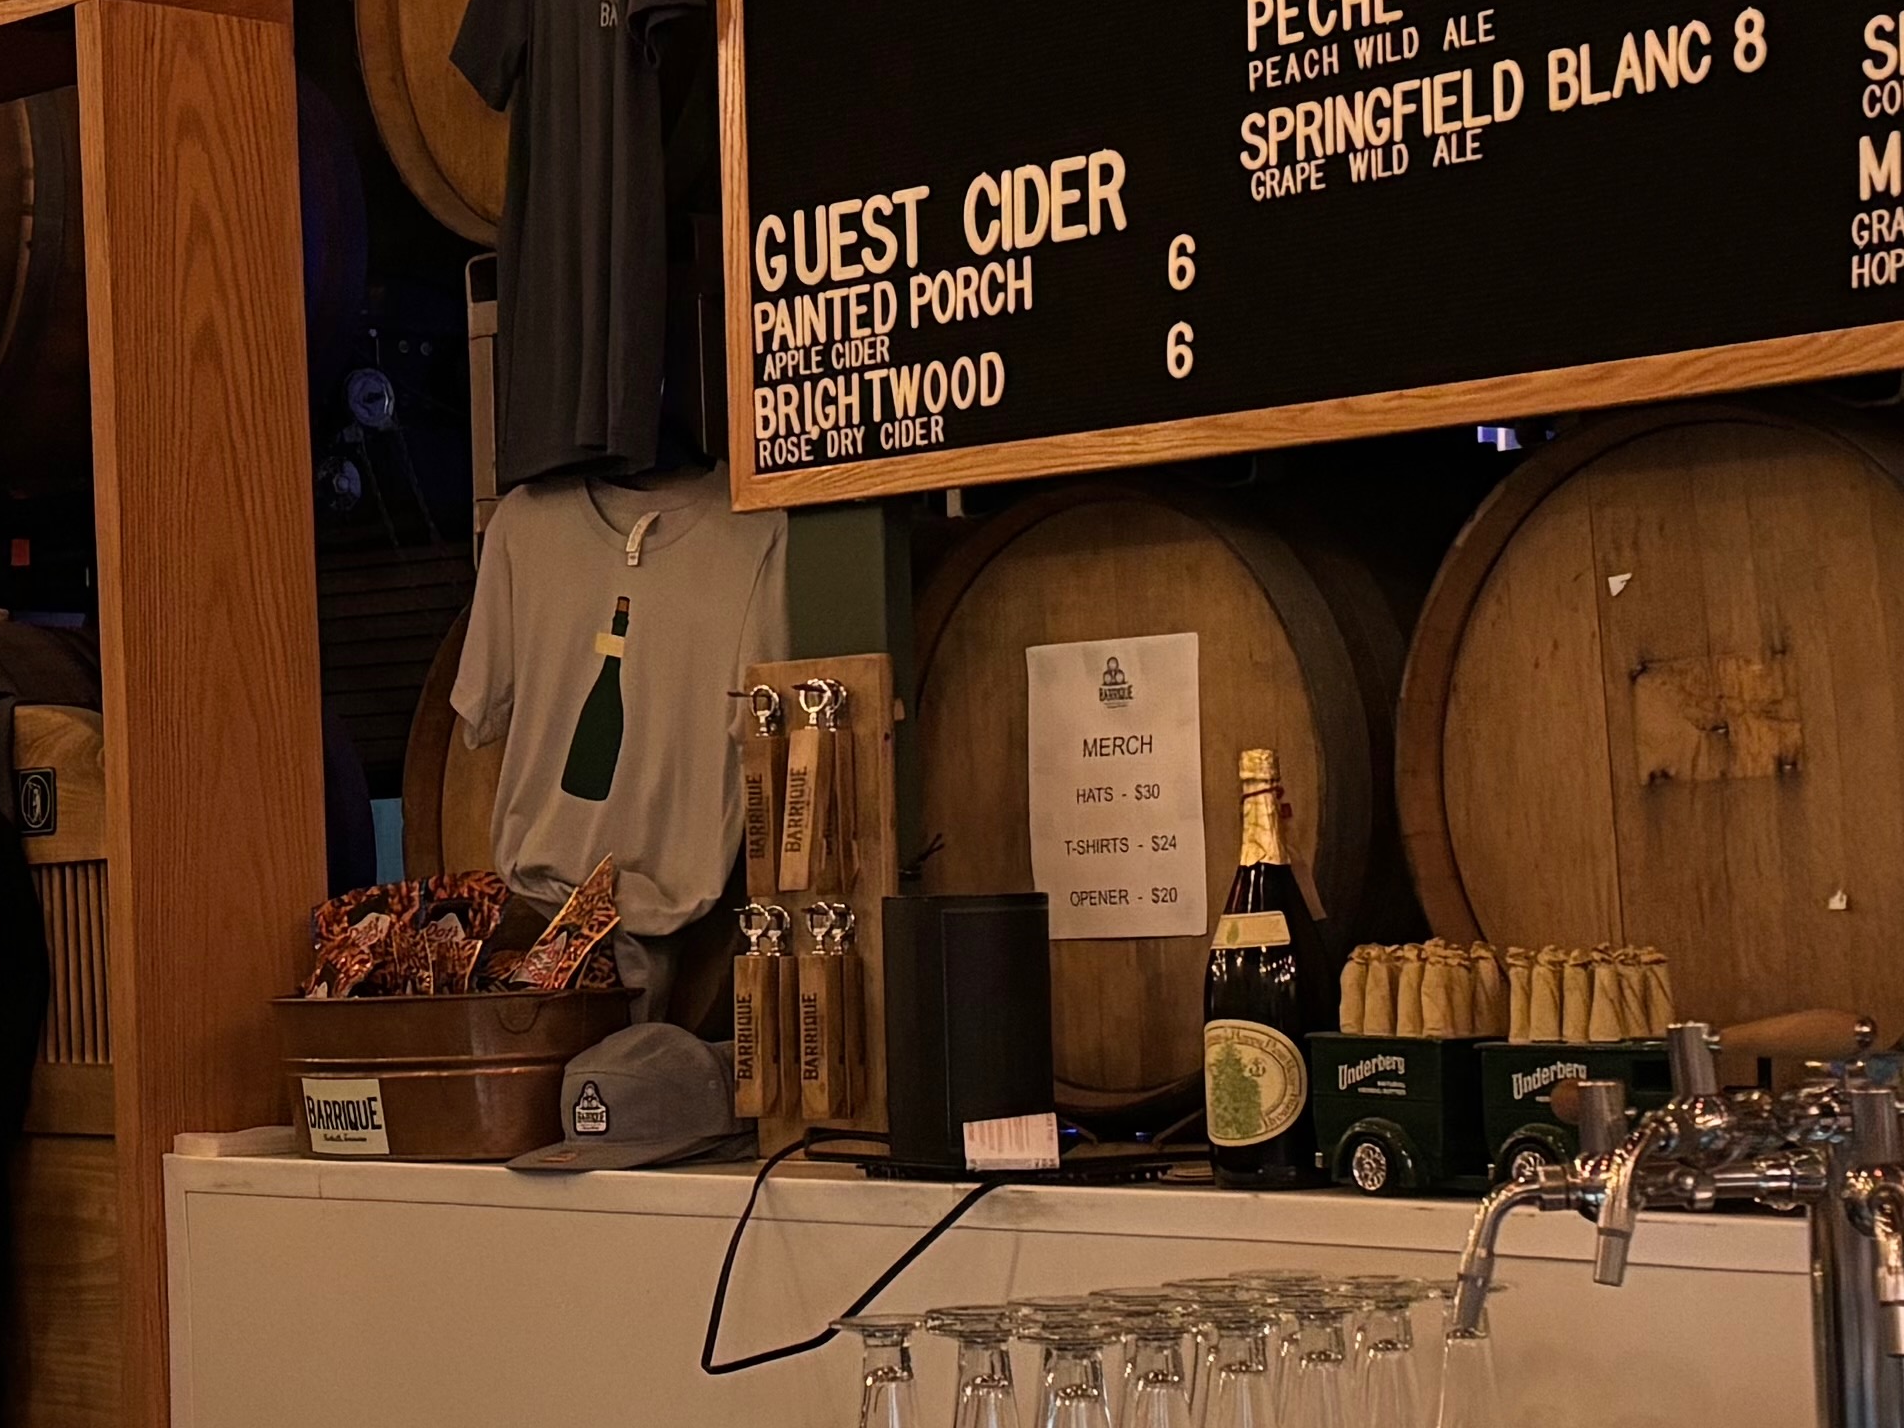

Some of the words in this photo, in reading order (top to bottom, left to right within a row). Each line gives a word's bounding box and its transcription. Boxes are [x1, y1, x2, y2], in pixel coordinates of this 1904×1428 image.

[1248, 43, 1340, 92] PEACH
[1354, 27, 1419, 70] WILD
[1443, 9, 1496, 52] ALE
[1240, 58, 1525, 171] SPRINGFIELD
[1547, 19, 1712, 111] BLANC
[1733, 6, 1767, 73] 8
[1250, 158, 1326, 202] GRAPE
[1348, 143, 1409, 184] WILD
[1432, 128, 1483, 169] ALE
[755, 185, 930, 292] GUEST
[963, 148, 1127, 256] CIDER
[754, 281, 897, 354] PAINTED
[910, 255, 1032, 329] PORCH
[1168, 233, 1196, 291] 6
[755, 352, 1005, 439] BRIGHTWOOD
[1166, 321, 1194, 379] 6
[763, 345, 824, 382] APPLE
[831, 336, 890, 371] CIDER
[827, 427, 865, 458] DRY
[880, 415, 944, 451] CIDER
[1083, 734, 1153, 758] MERCH
[746, 773, 766, 859] BARRIQUE
[785, 766, 807, 853] BARRIQUE
[1076, 787, 1114, 805] HATS
[1134, 783, 1160, 801] $30
[1064, 837, 1129, 856] T-SHIRTS
[1151, 834, 1177, 853] $24
[1070, 889, 1130, 907] OPENER
[1151, 886, 1178, 904] $20
[736, 993, 753, 1080] BARRIQUE
[802, 993, 819, 1081] BARRIQUE
[1338, 1054, 1405, 1090] Underberg
[306, 1095, 382, 1131] BARRIQUE
[1512, 1060, 1587, 1100] Underberg
